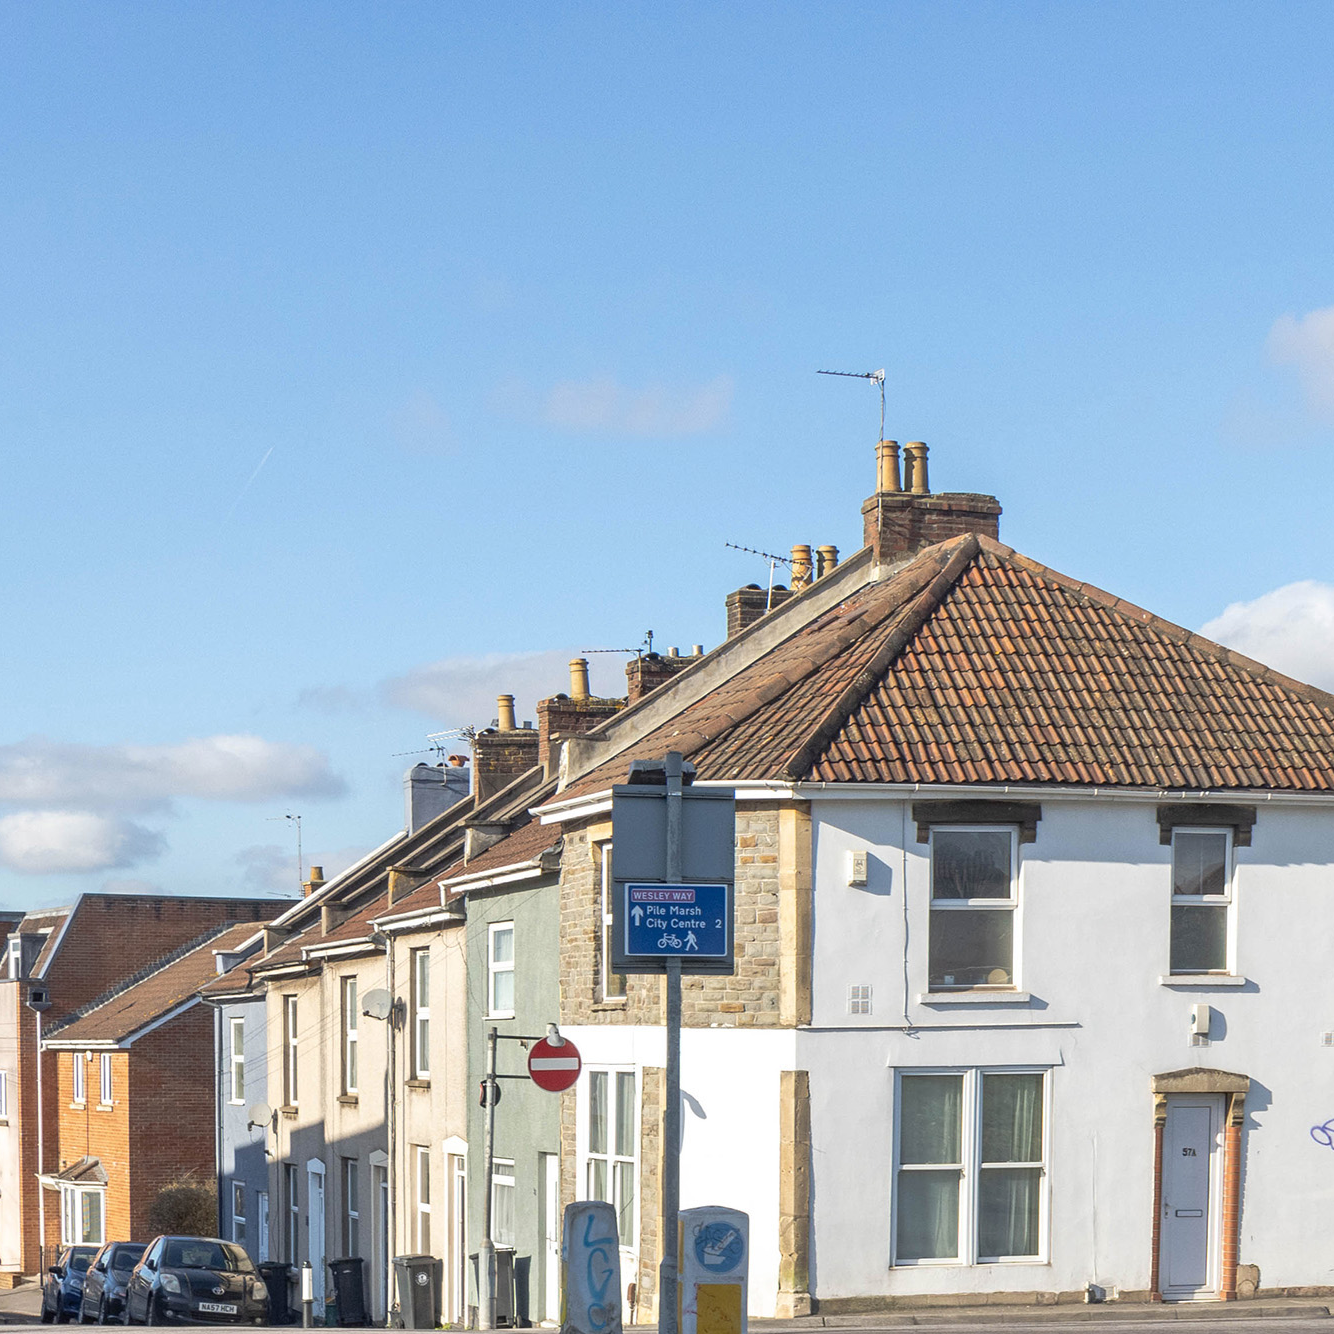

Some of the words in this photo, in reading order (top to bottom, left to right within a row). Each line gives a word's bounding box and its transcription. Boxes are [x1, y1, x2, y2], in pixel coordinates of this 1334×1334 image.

[633, 892, 670, 900] WESLEY
[672, 892, 692, 901] WAY
[647, 905, 666, 915] Pile
[670, 906, 702, 916] Marsh
[646, 918, 667, 930] City
[671, 918, 706, 929] Centre
[715, 919, 722, 929] 2
